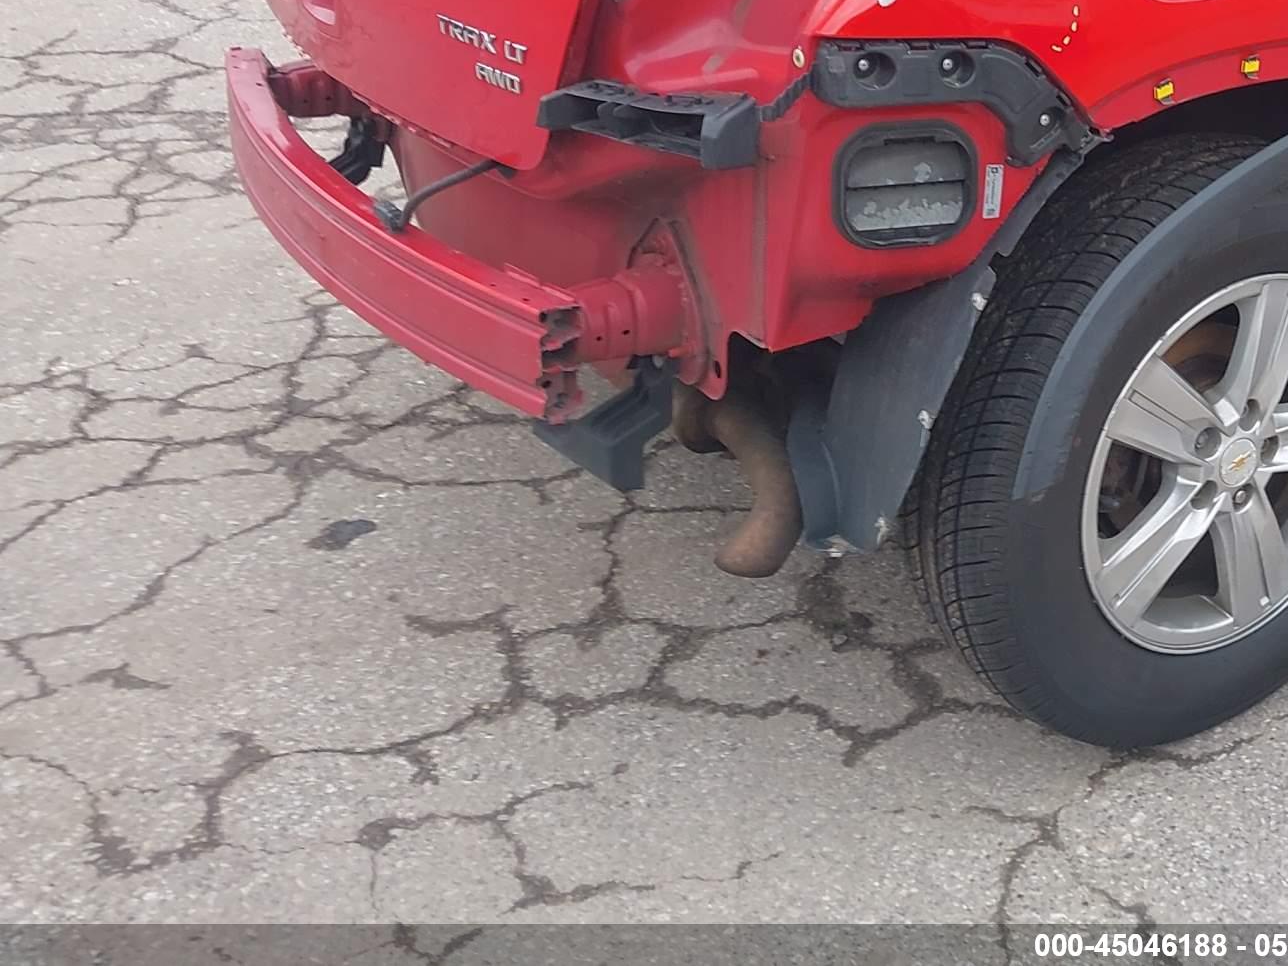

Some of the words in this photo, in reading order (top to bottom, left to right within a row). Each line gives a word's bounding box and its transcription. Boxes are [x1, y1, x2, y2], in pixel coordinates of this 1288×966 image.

[435, 12, 497, 54] TRAX
[504, 39, 528, 65] LT
[474, 61, 521, 95] AWD
